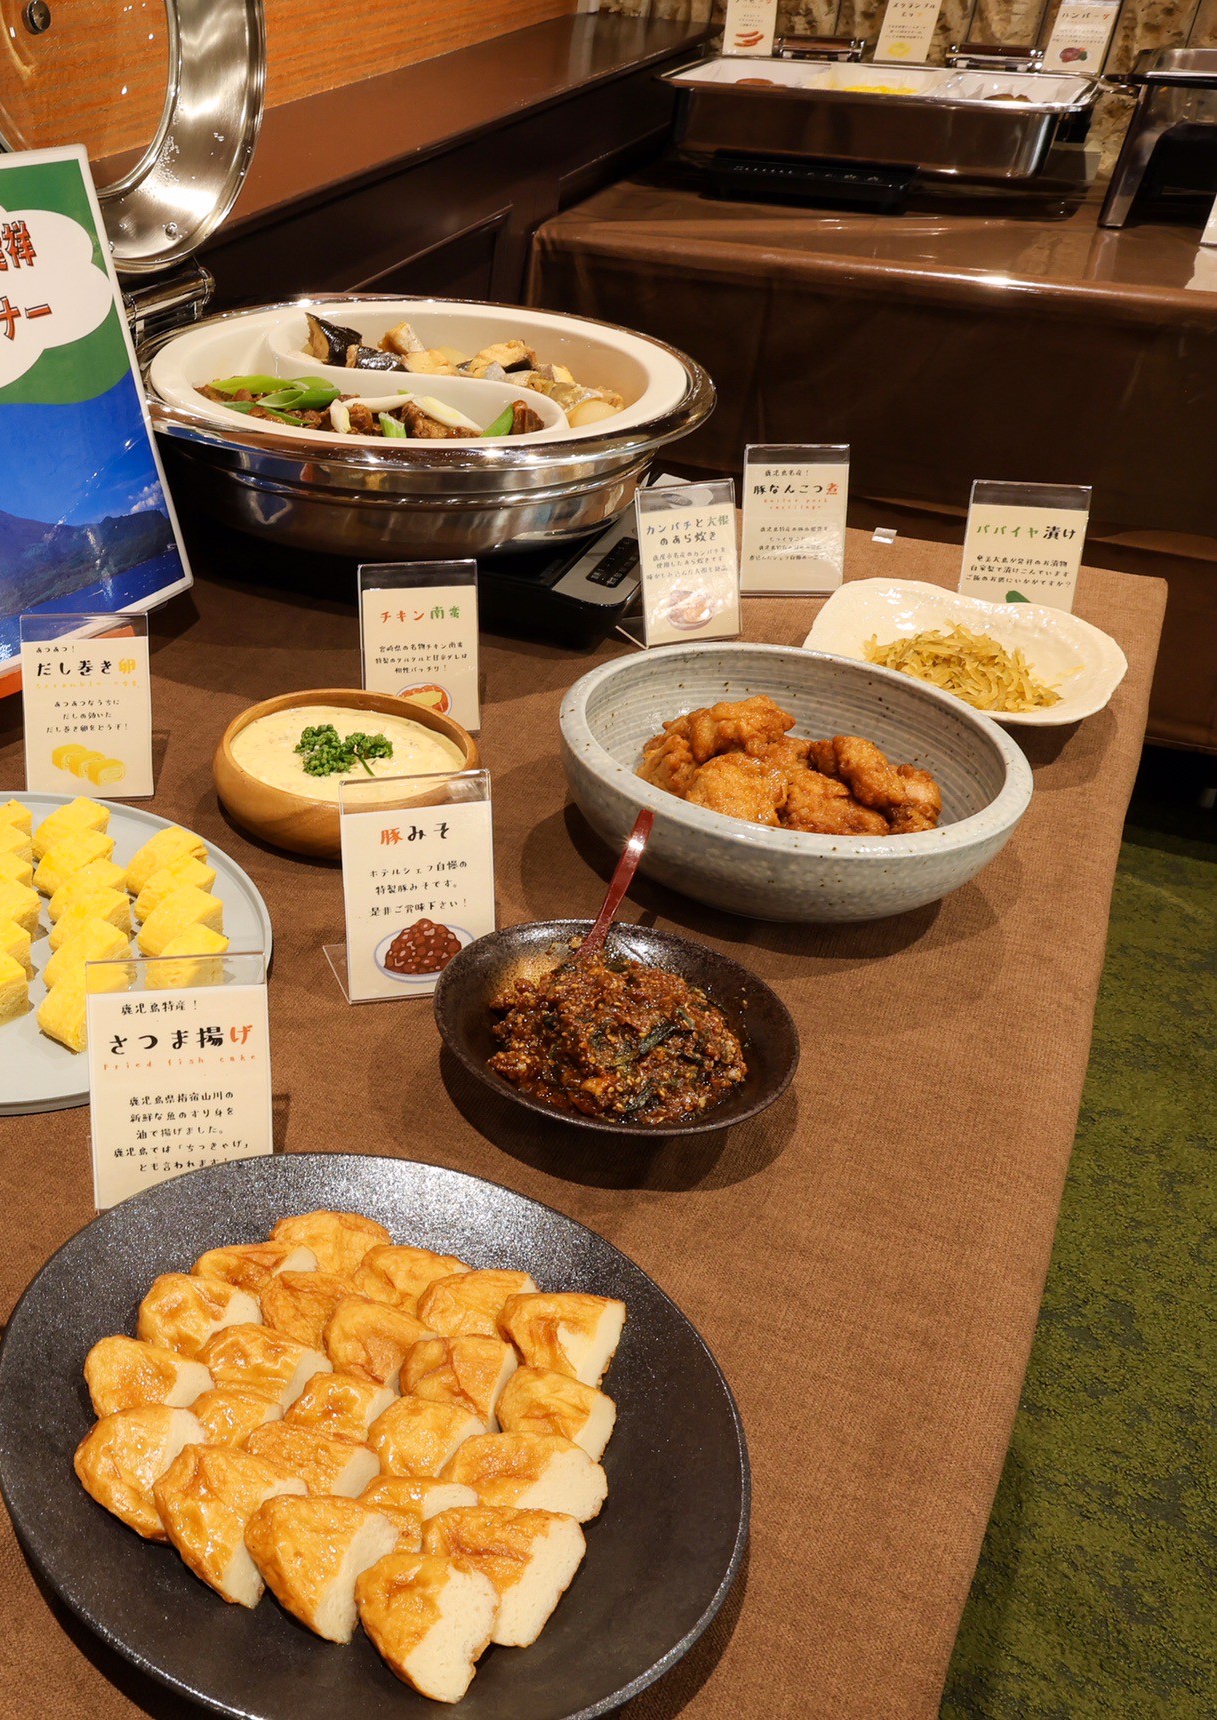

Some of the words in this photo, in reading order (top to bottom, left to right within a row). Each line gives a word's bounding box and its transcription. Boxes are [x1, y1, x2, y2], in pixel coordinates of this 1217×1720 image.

[753, 482, 839, 495] 豚なんこつ煮
[660, 531, 717, 546] のあら炊き
[976, 524, 1076, 540] パパイヤ漬け
[380, 605, 460, 623] チキン南蛮
[37, 658, 136, 677] だし巻き卵
[380, 822, 450, 845] 豚みそ
[370, 860, 468, 878] ホテルシェフ自慢の
[375, 879, 457, 895] 特製豚みそです。
[370, 898, 467, 917] 是非ご賞味下さい！
[121, 1000, 197, 1016] 鹿児島特産！
[109, 1024, 253, 1055] さつま揚げ
[129, 1091, 234, 1107] 鹿児島県指宿山川の
[129, 1107, 234, 1123] 新鮮な魚のすり身を
[136, 1126, 223, 1140] 油で揚げました。
